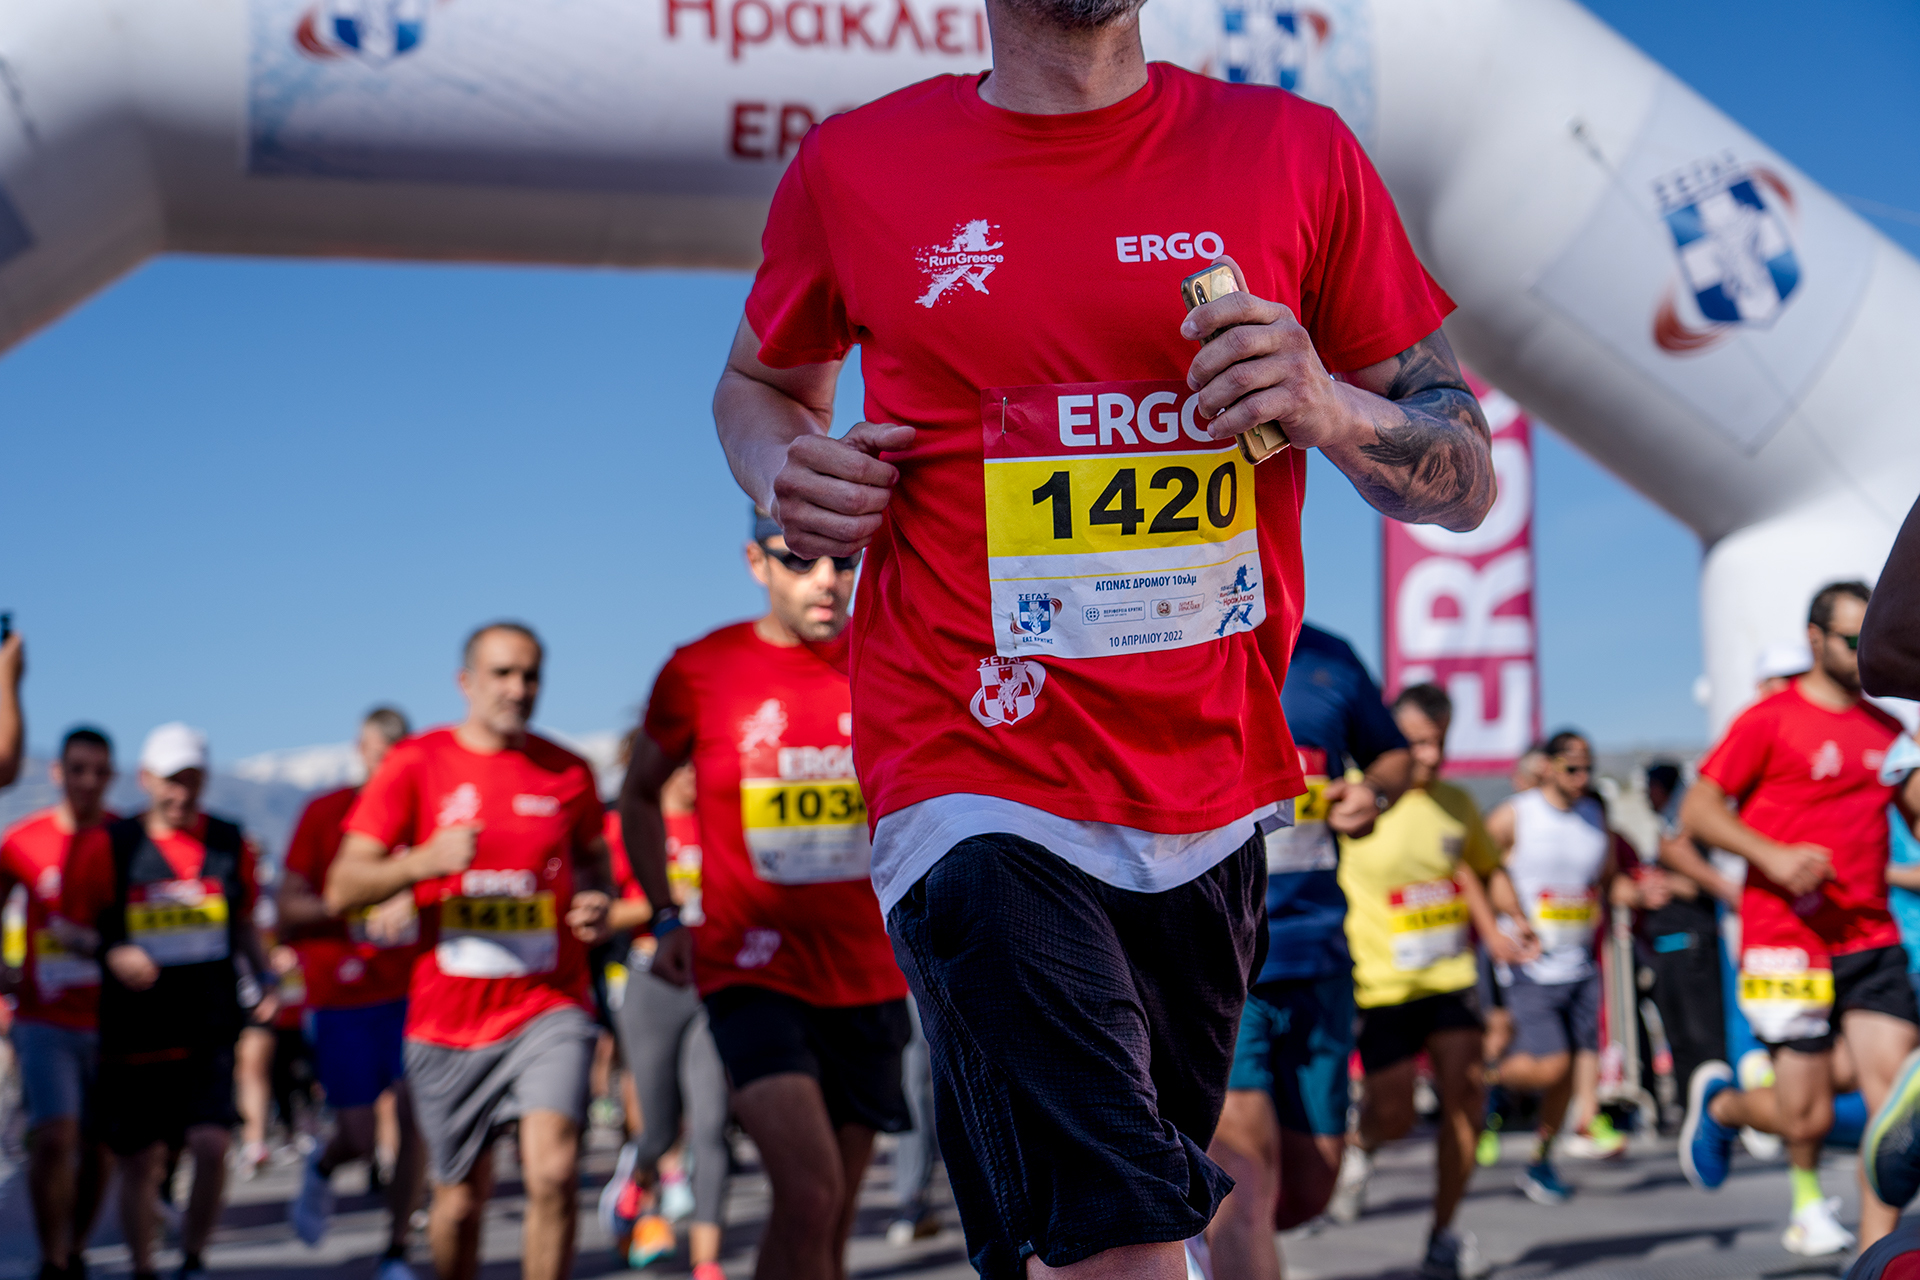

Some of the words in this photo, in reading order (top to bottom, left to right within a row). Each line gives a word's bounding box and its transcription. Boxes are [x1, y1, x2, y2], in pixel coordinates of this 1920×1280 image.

[1115, 231, 1225, 263] ERGO
[929, 253, 1004, 268] RunGreece
[1032, 461, 1237, 539] 1420
[1095, 579, 1132, 592] ΑΓΩΝΑΣ
[1133, 576, 1171, 589] ΔΡΟΜΟΥ
[1109, 636, 1120, 648] 10
[1121, 633, 1162, 647] ΑΠΡΙΛΙΟΥ
[1164, 630, 1183, 642] 2022
[767, 786, 869, 823] 103
